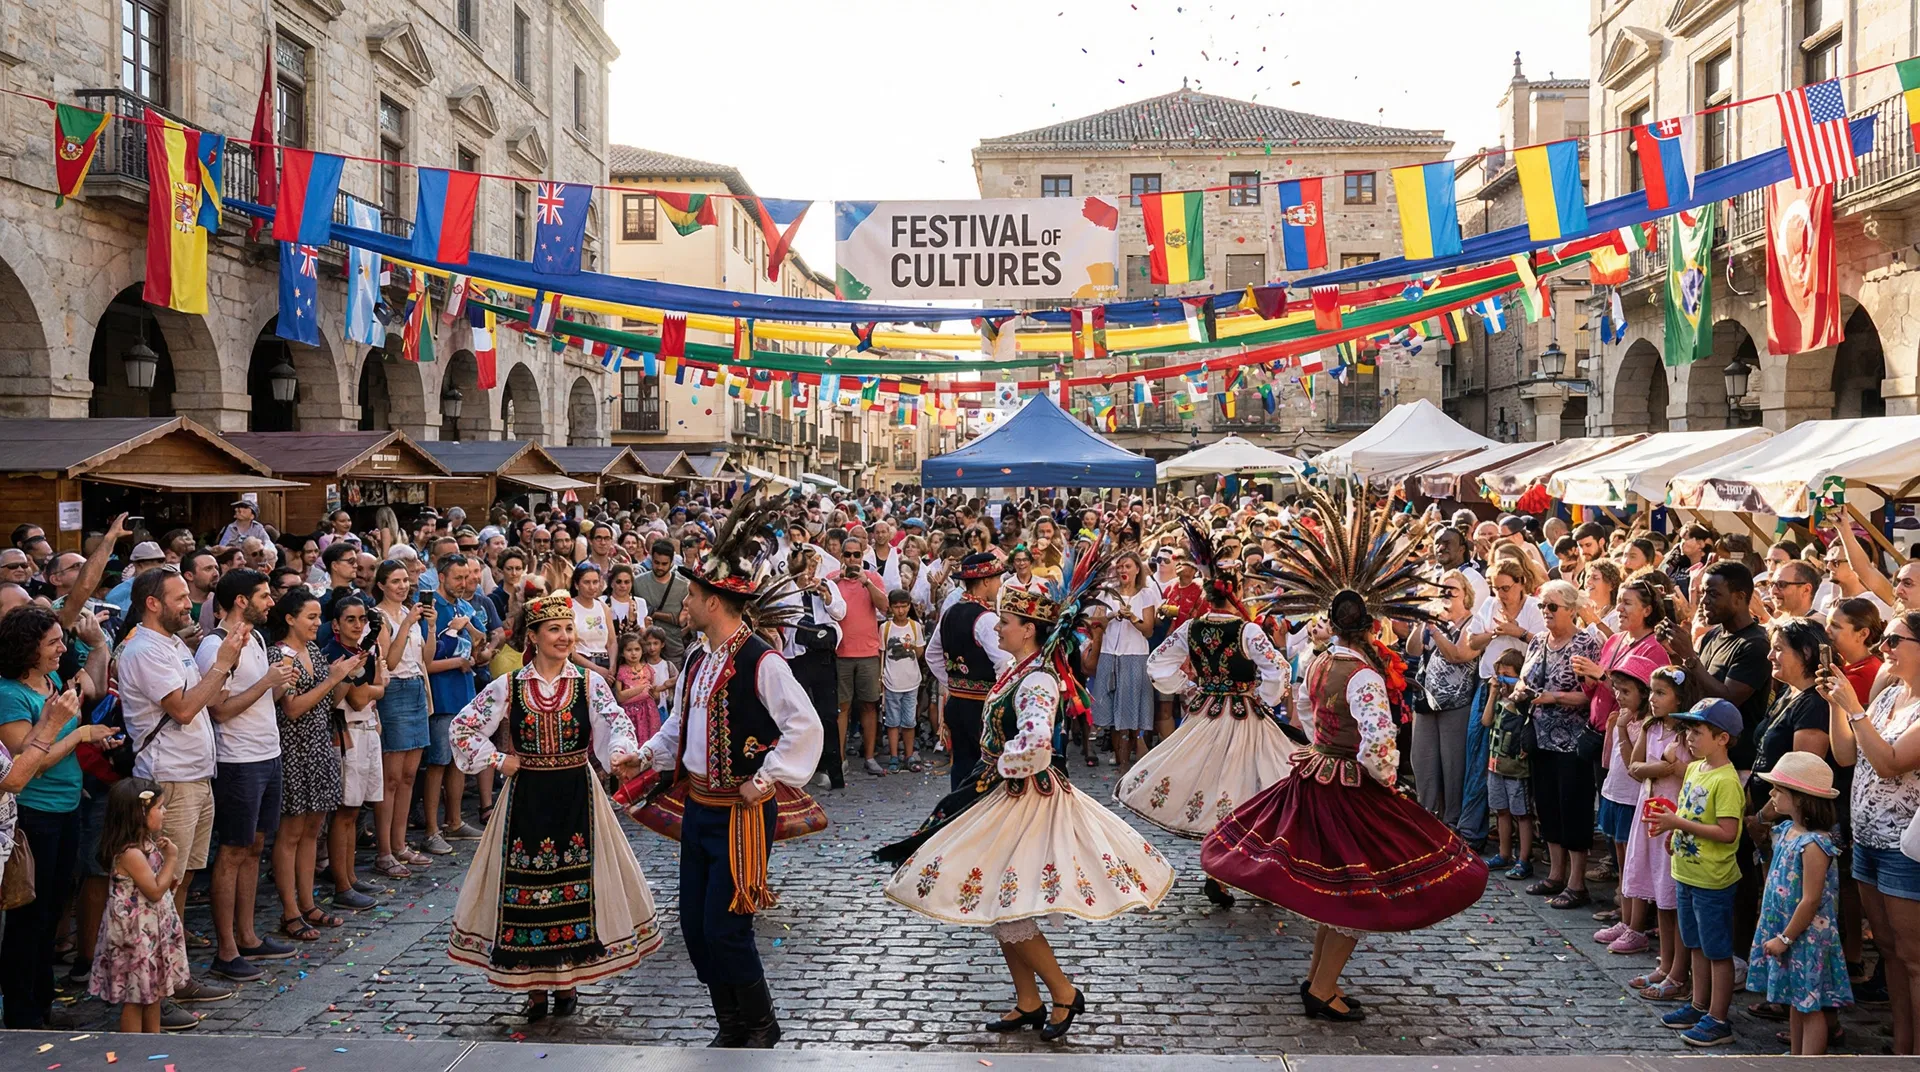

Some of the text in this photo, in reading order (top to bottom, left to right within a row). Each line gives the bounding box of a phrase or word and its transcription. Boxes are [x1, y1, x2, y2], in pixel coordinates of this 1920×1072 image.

[891, 213, 1062, 248] FESTIVAL OF
[891, 251, 1062, 288] CULTURES
